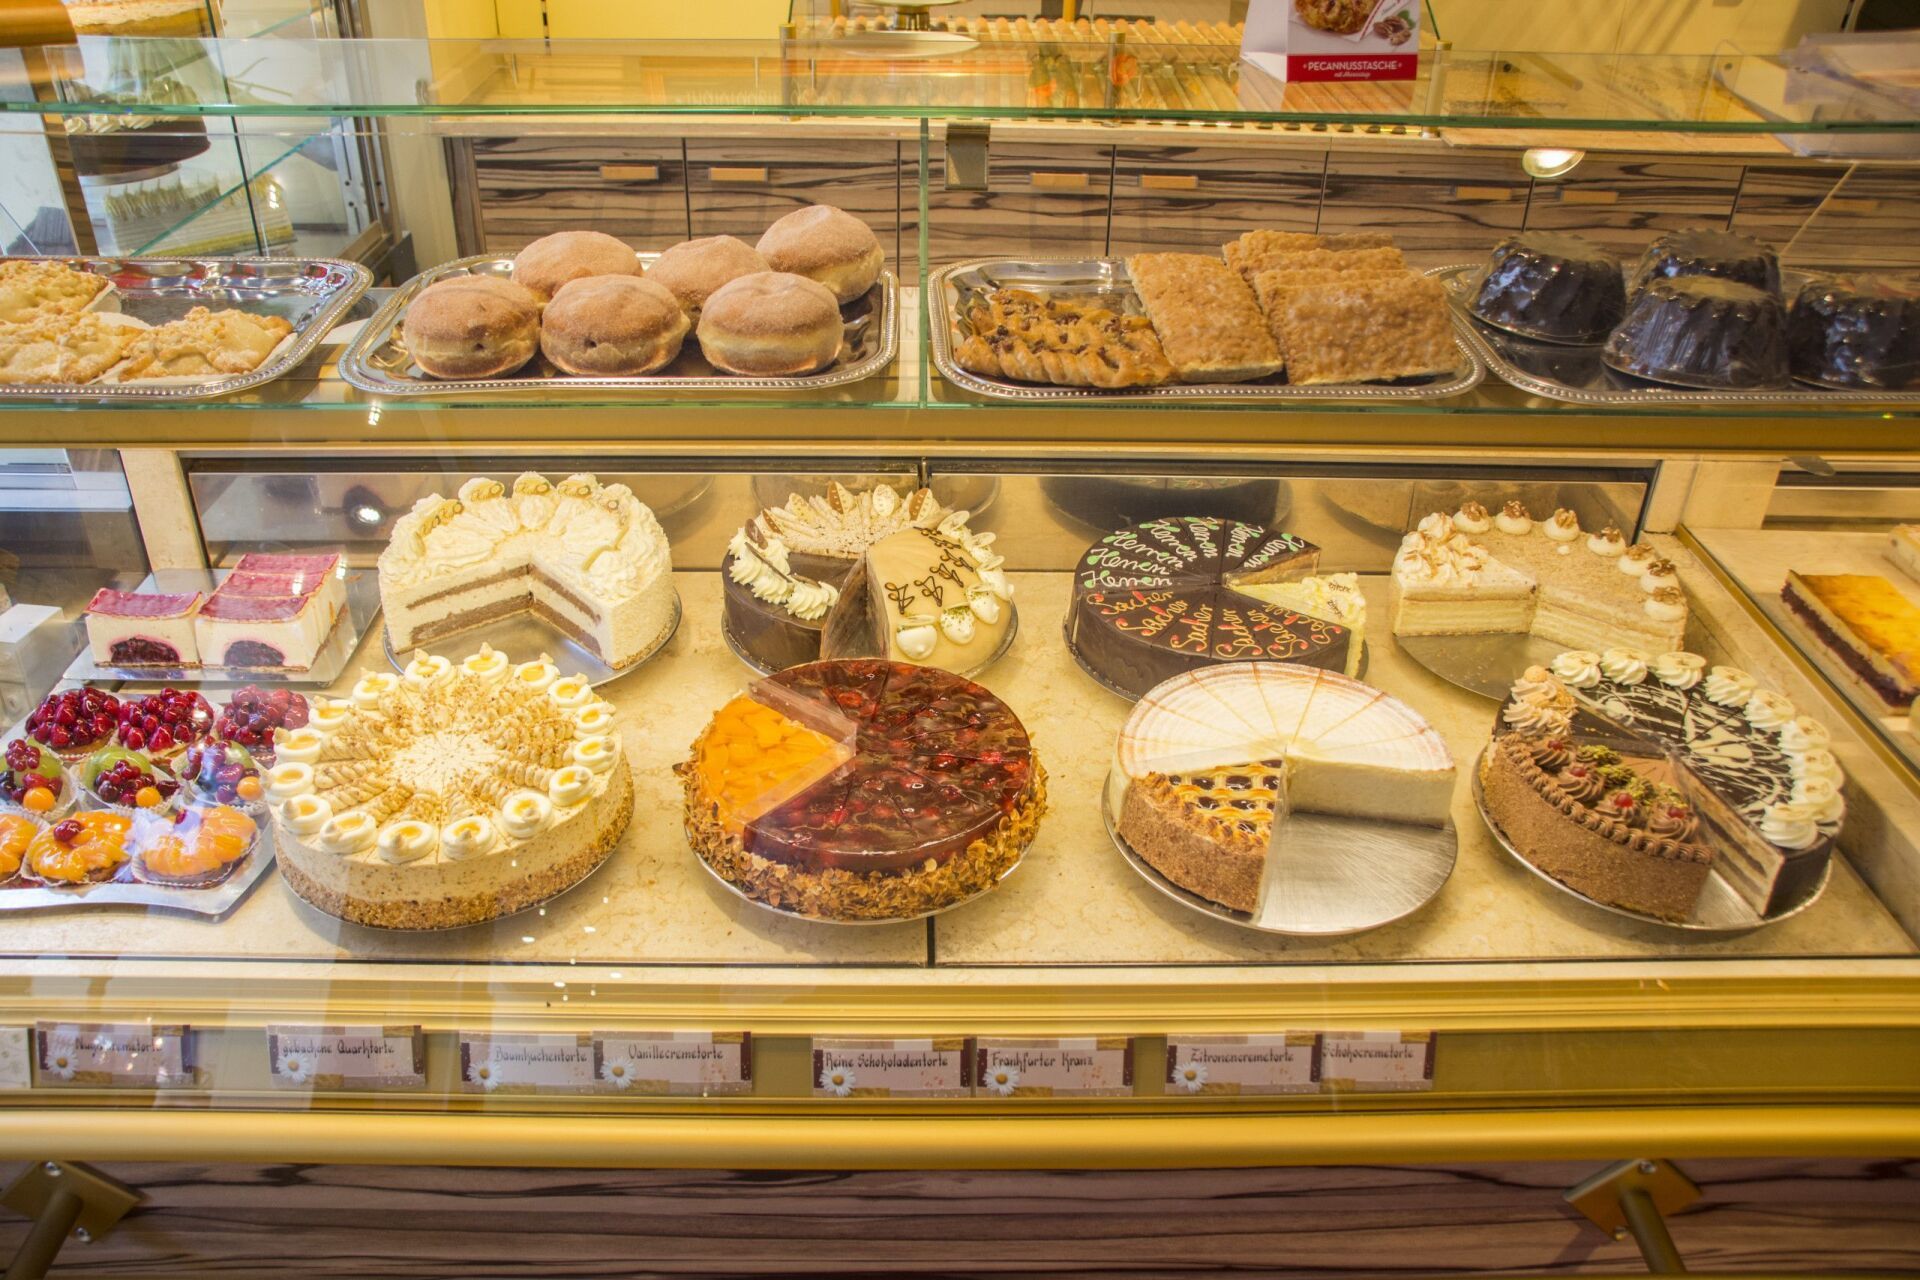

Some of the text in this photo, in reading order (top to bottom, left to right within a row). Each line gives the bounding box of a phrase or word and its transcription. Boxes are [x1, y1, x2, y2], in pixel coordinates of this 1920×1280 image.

[1308, 60, 1398, 71] PECANNUSSTASCHE
[337, 1039, 394, 1058] Quarktorte
[494, 1045, 588, 1065] Baumkuchentorte
[628, 1043, 724, 1060] Vanillecremetorte
[825, 1046, 949, 1070] Reine Schokoladentorte
[991, 1050, 1094, 1073] Frankfurter Kranz
